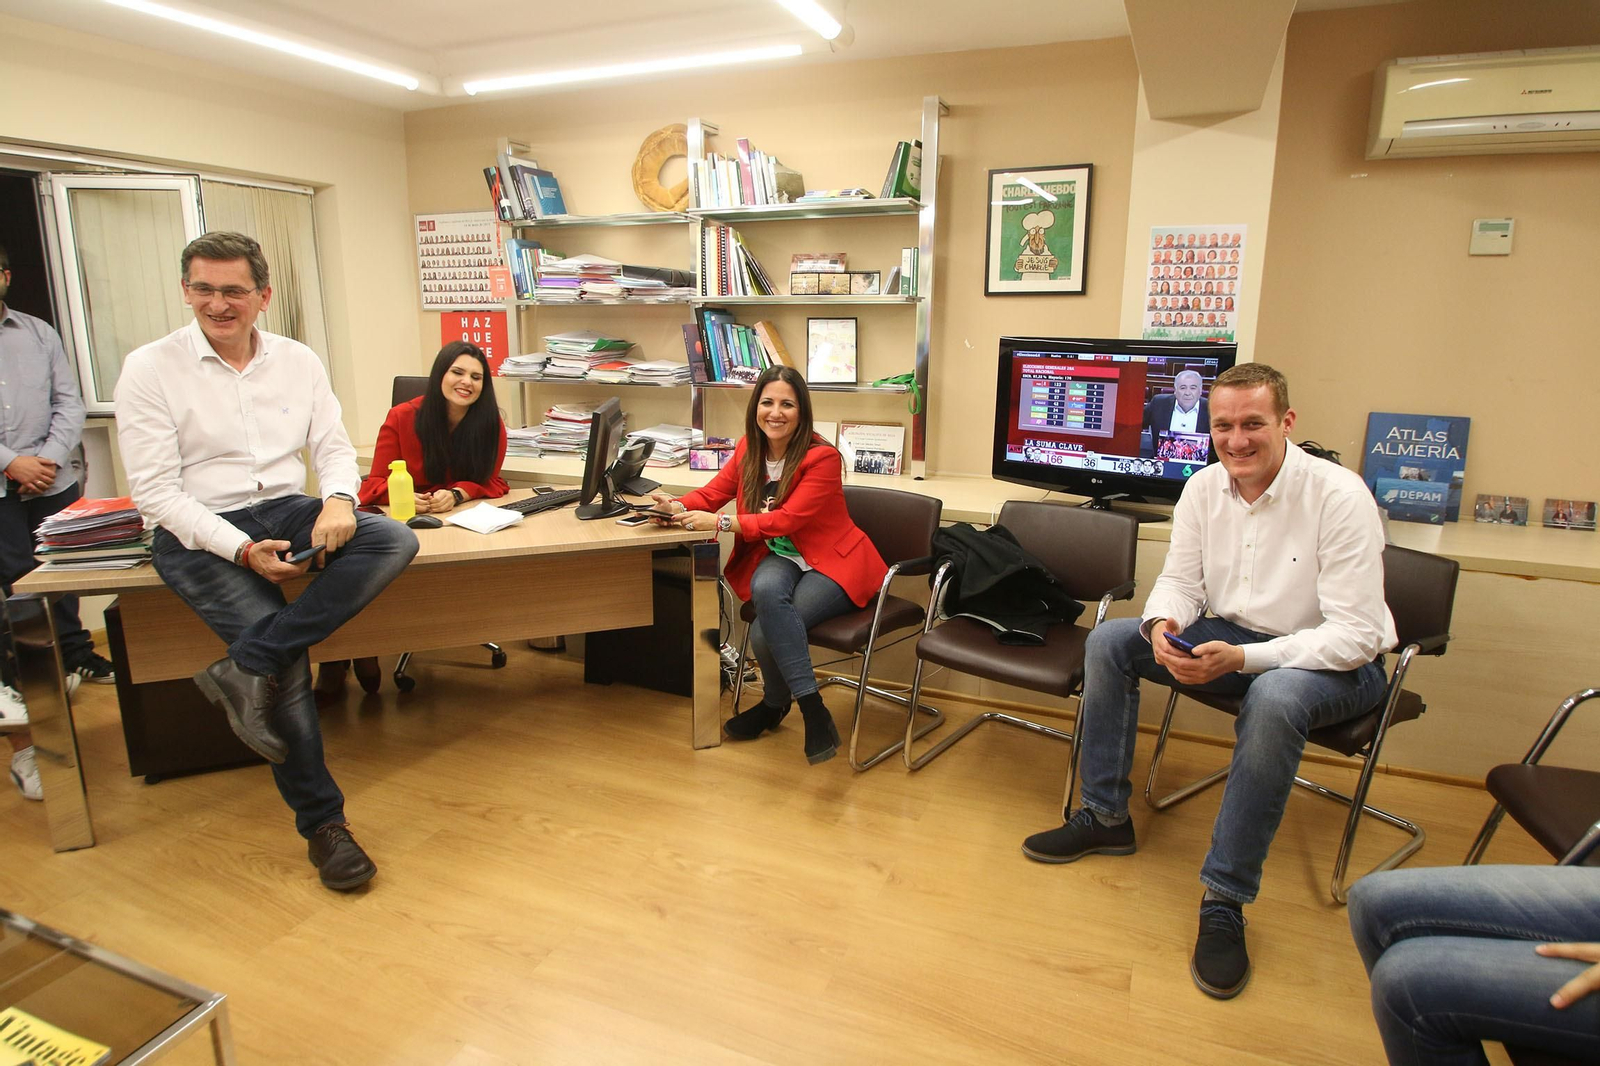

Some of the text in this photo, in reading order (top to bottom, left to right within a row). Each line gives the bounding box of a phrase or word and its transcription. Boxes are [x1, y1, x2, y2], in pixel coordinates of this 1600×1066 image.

[461, 316, 491, 328] HAZ
[462, 332, 492, 343] QUE
[1386, 426, 1448, 443] ATLAS
[1036, 440, 1057, 449] SUMA
[1058, 442, 1083, 451] CLAVE
[1371, 442, 1460, 460] ALMERÍA
[1046, 454, 1063, 464] 166
[1083, 458, 1096, 468] 36
[1112, 461, 1131, 472] 148
[1399, 489, 1442, 502] DEPAM
